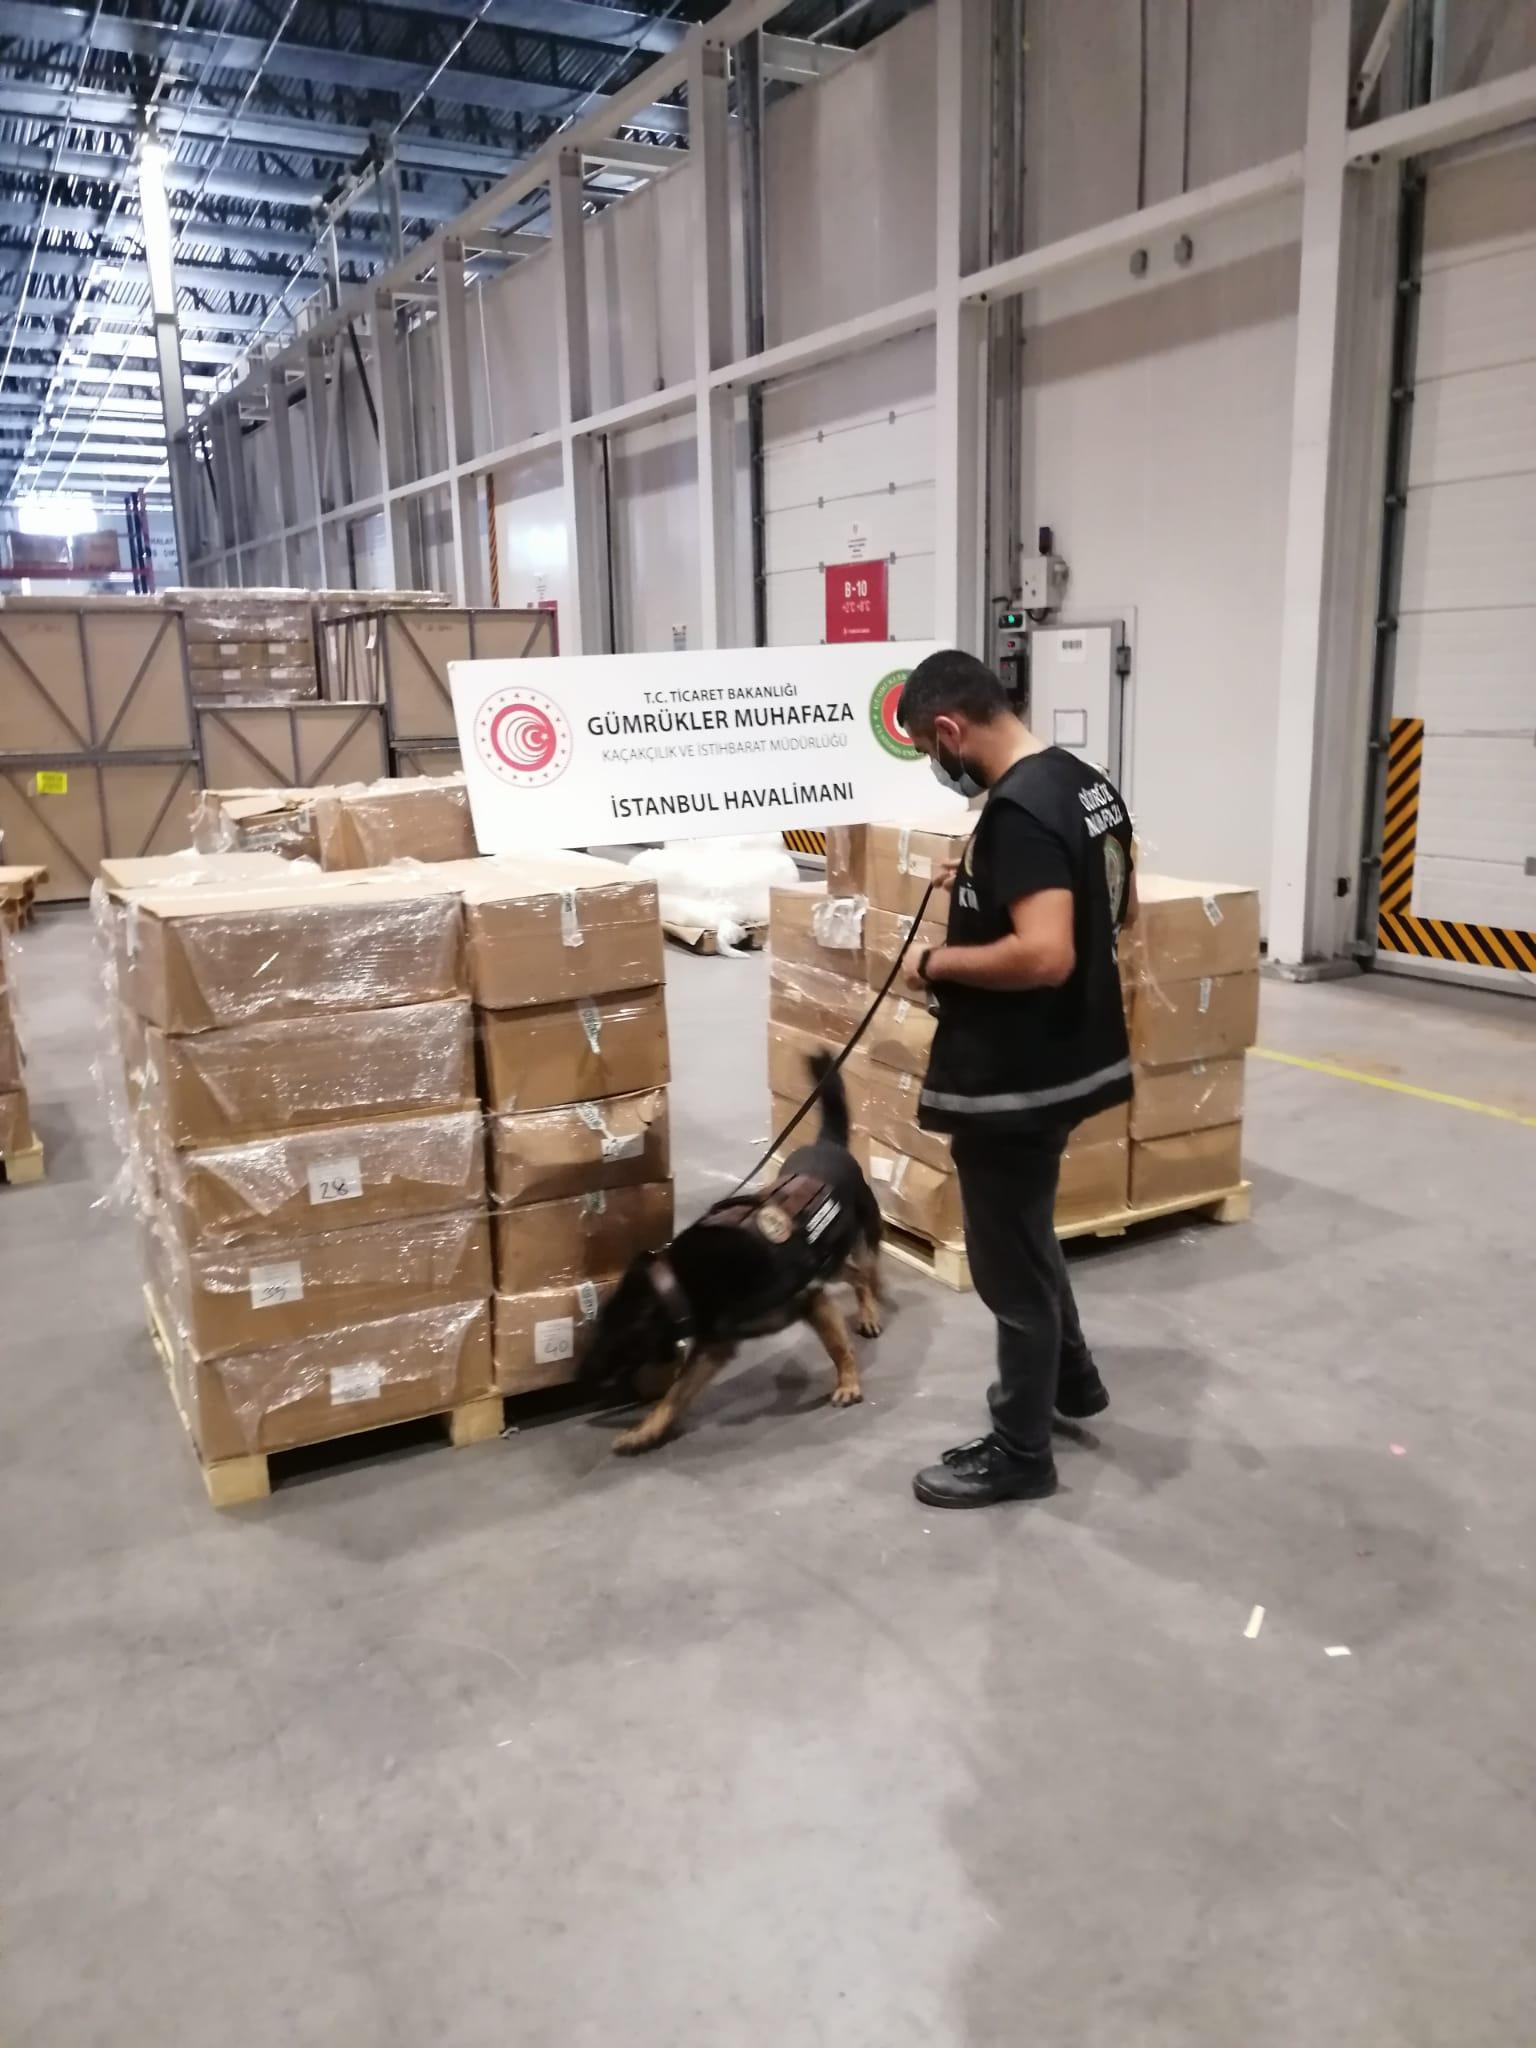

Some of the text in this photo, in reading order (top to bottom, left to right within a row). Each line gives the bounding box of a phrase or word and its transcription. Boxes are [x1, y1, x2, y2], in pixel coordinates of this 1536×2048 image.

[844, 579, 868, 598] B-10
[644, 681, 798, 704] T.C. TİCARET BAKANLIĞI
[587, 702, 855, 736] GÜMRÜKLER MUHAFAZA
[602, 732, 848, 763] KAÇAKÇILIK VE İSTİHBARAT MÜDÜRLÜĞÜ
[610, 781, 854, 819] İSTANBUL HAVALİMANI
[320, 1177, 349, 1199] 28
